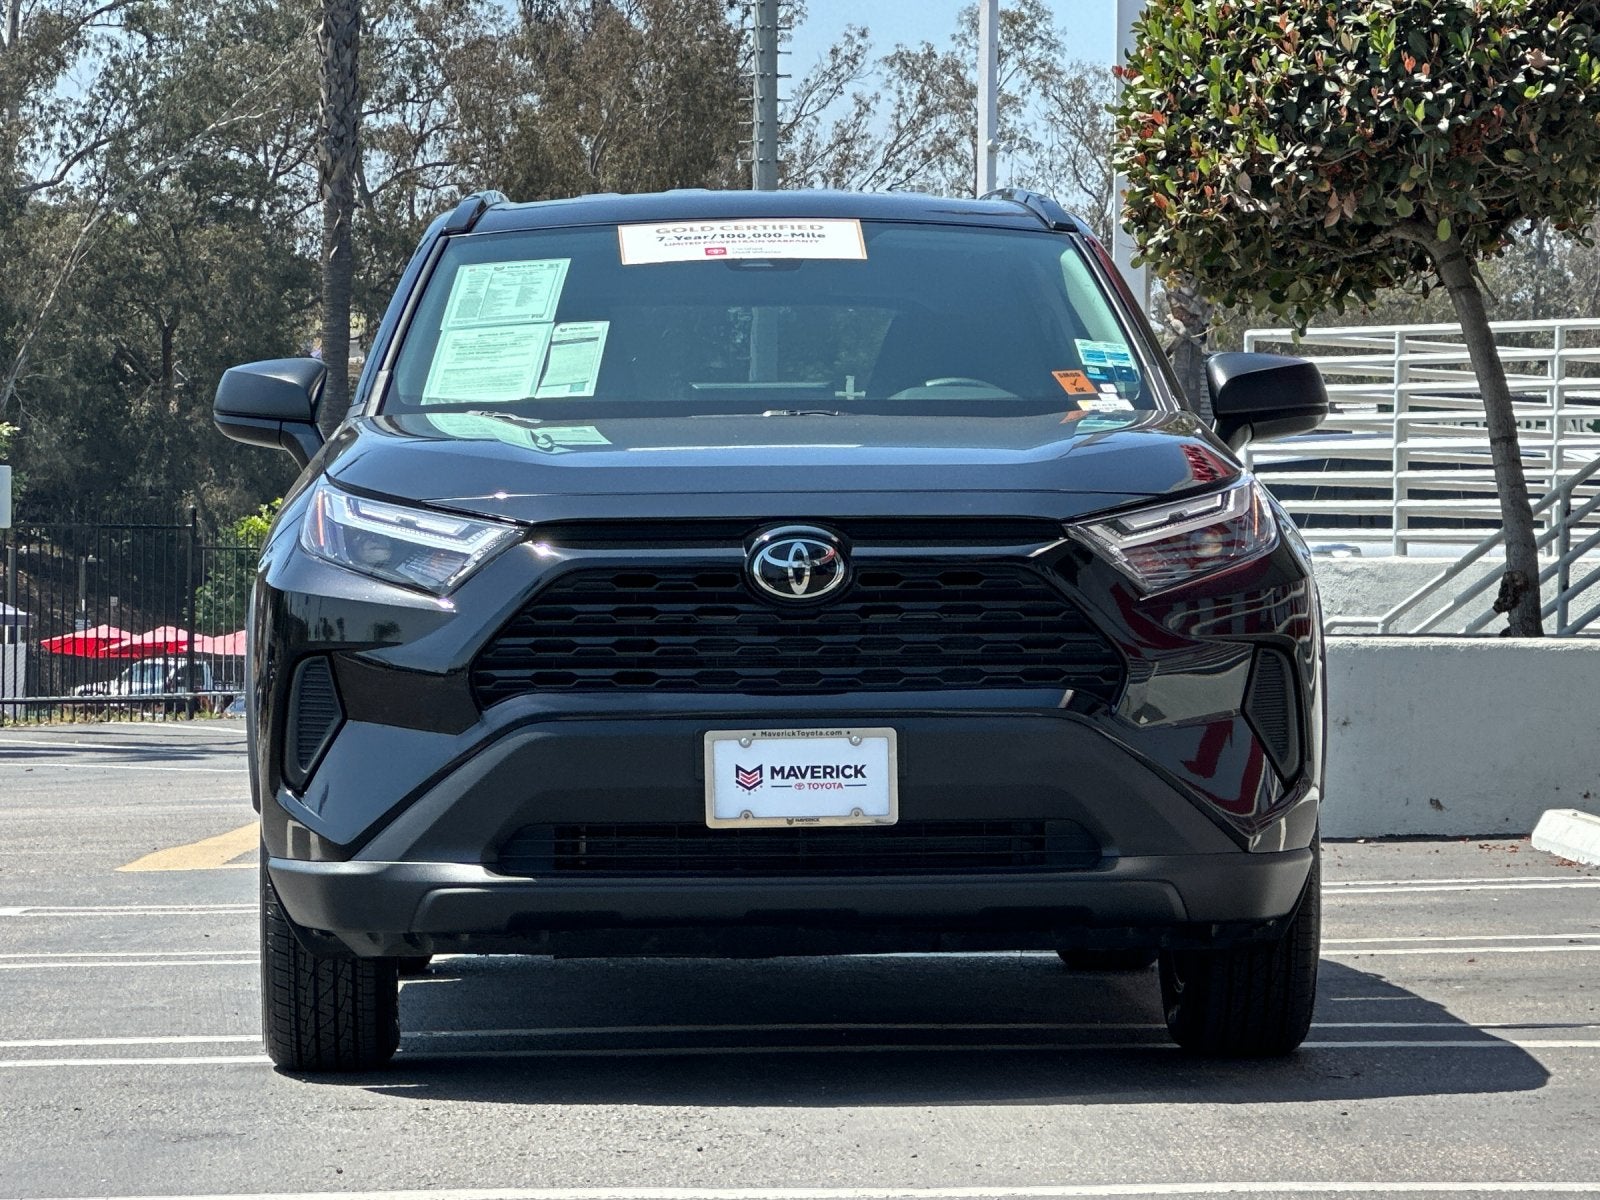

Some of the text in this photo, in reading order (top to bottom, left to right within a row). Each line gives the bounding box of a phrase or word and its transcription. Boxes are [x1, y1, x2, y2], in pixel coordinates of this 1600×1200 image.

[655, 225, 715, 235] GOLD
[656, 232, 826, 242] 7-Year/100,000-Mile
[760, 729, 843, 739] MaverickToyota.com
[770, 764, 867, 780] MAVERICK
[807, 781, 844, 790] TOYOTA
